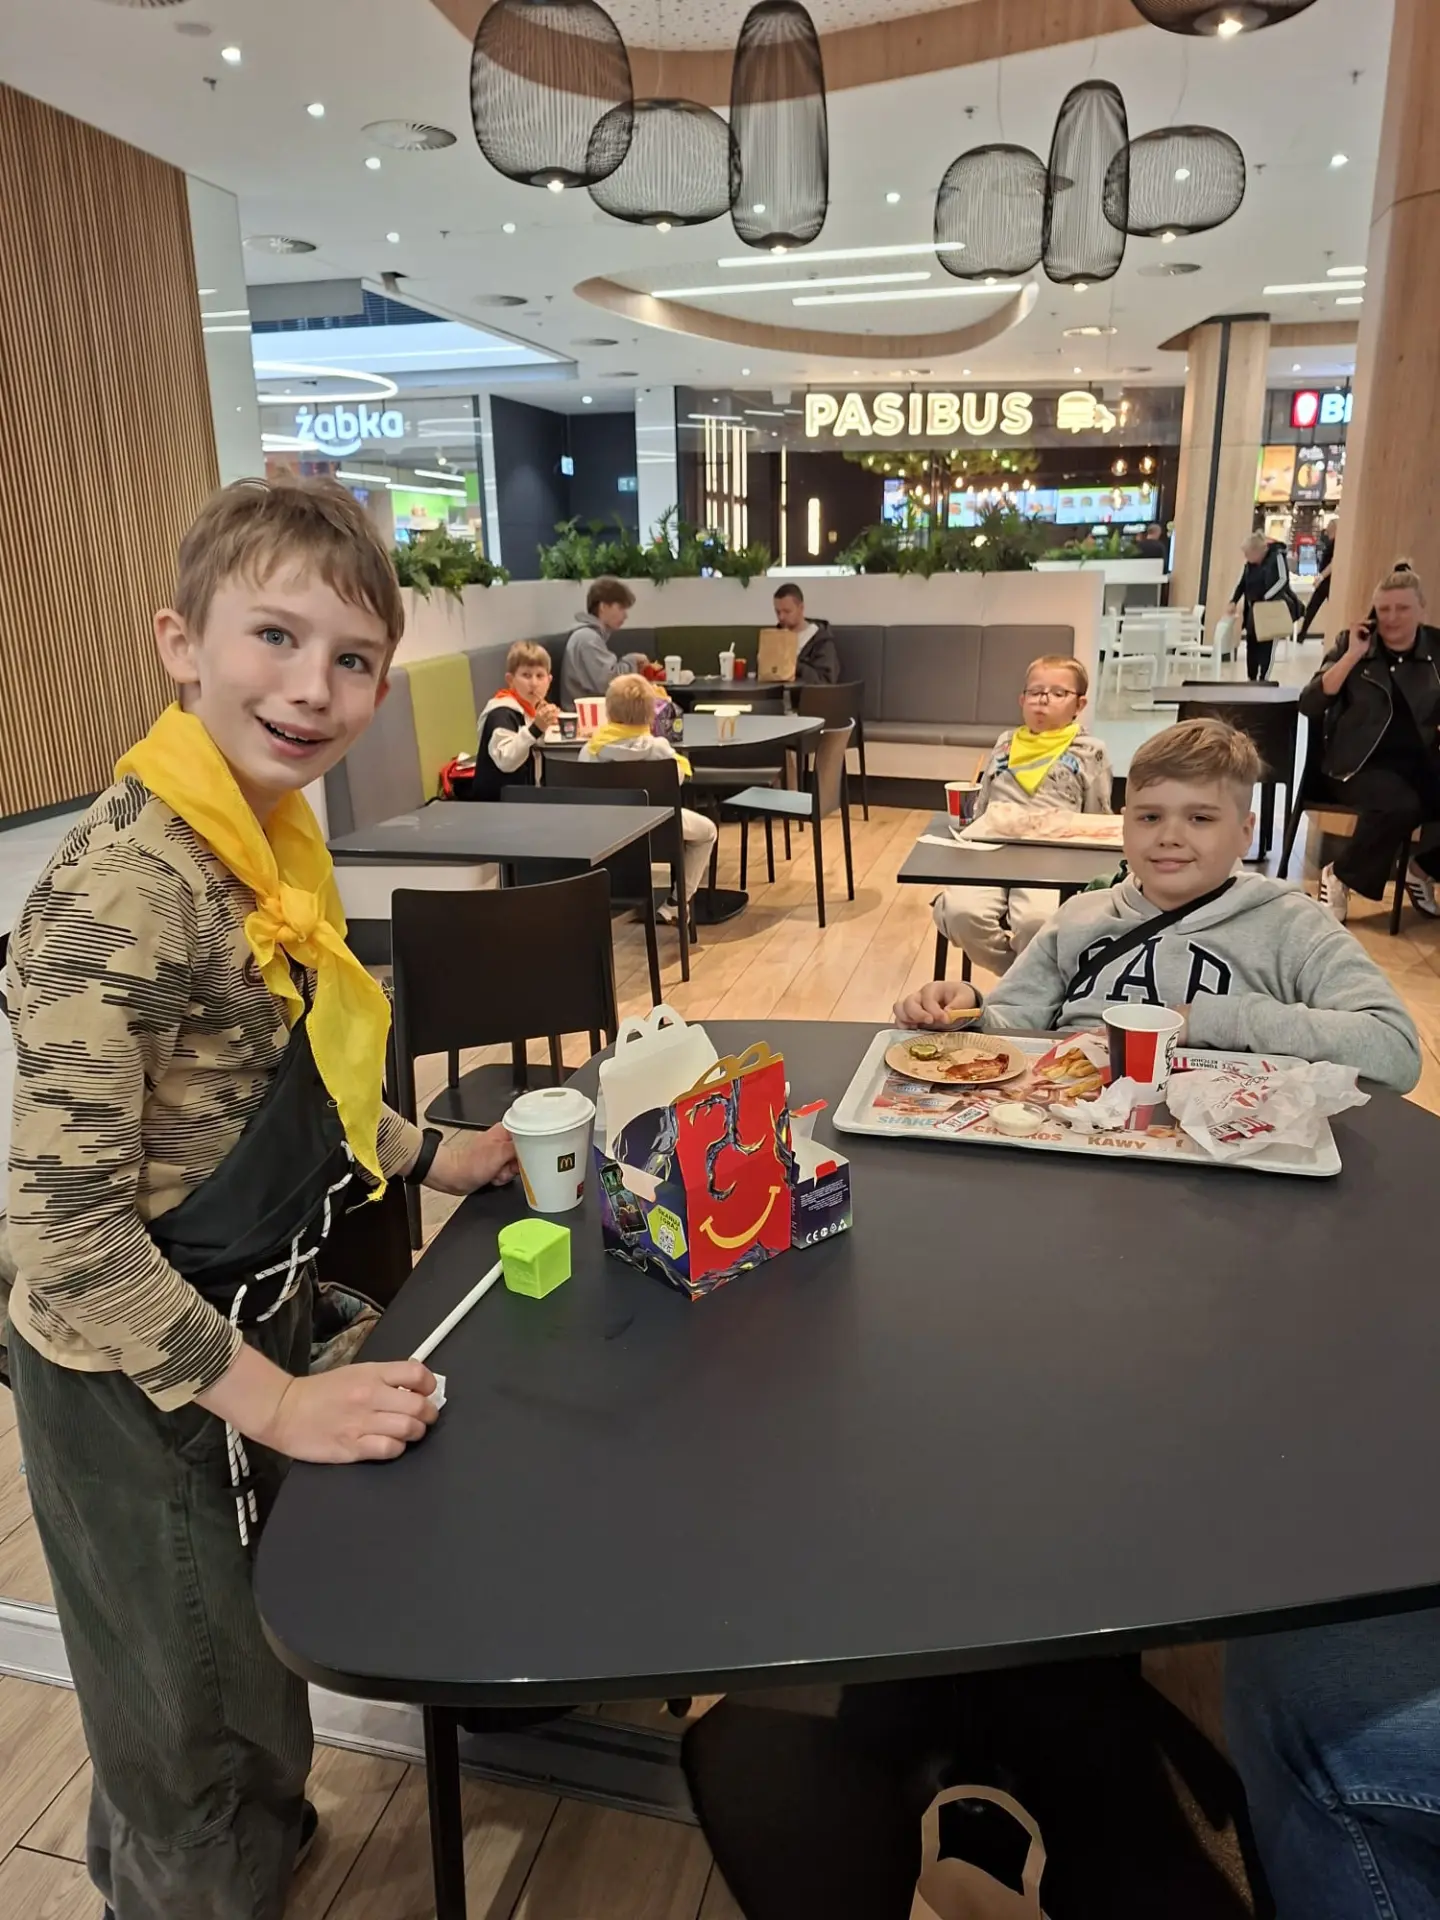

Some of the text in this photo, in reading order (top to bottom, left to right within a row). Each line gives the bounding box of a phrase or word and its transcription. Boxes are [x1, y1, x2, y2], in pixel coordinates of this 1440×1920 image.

[295, 404, 404, 440] żabka
[805, 392, 1033, 437] PASIBUS
[1088, 1137, 1146, 1149] KAWY
